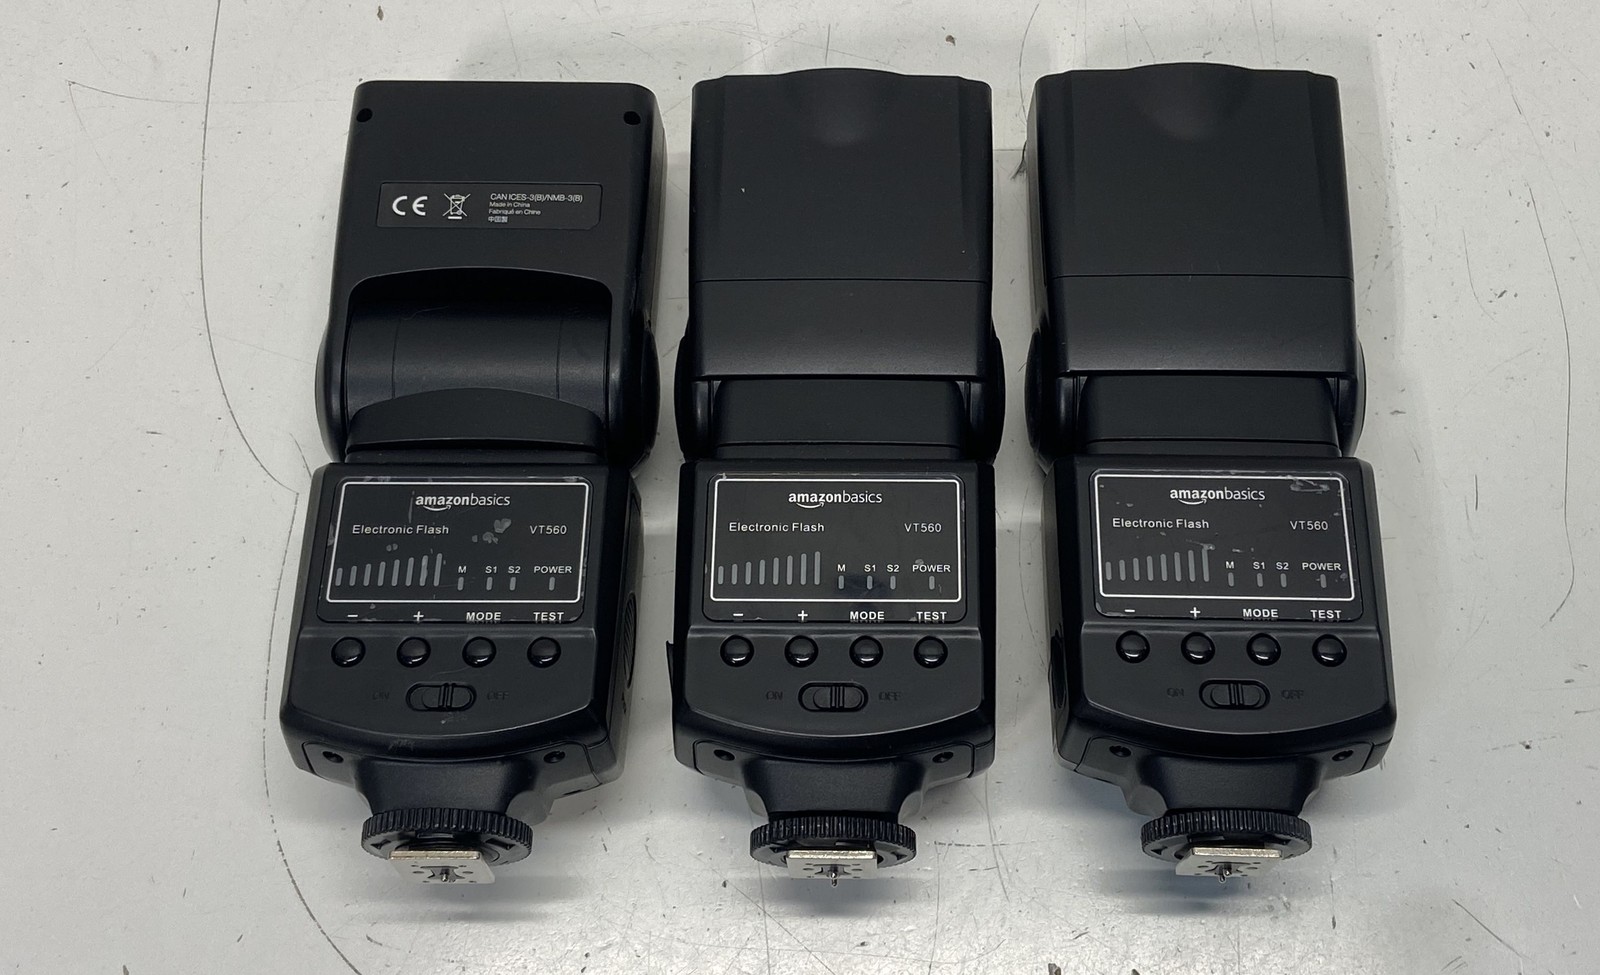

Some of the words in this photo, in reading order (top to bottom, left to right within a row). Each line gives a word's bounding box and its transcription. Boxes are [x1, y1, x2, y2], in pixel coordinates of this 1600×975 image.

[490, 193, 508, 201] CAN
[508, 193, 583, 203] ICES-3(B)/NMB-3(B)
[788, 490, 883, 509] amazonbasics
[1170, 488, 1265, 505] amazonbasics
[415, 493, 511, 511] amazonbasics
[729, 522, 789, 532] Electronic
[792, 523, 825, 532] Flash
[904, 523, 942, 533] VT560
[1112, 518, 1173, 528] Electronic
[1176, 519, 1209, 529] Flash
[1290, 521, 1328, 530] VT560
[352, 524, 413, 535] Electronic
[416, 525, 449, 534] Flash
[529, 526, 567, 535] VT560
[1226, 561, 1234, 569] M
[1275, 562, 1289, 570] S2
[1301, 563, 1341, 571] POWER
[508, 566, 521, 574] S2
[533, 566, 572, 574] POWER
[466, 612, 501, 621] MODE
[533, 612, 564, 621] TEST
[849, 611, 885, 620] MODE
[916, 611, 947, 620] TEST
[1242, 608, 1279, 618] MODE
[1310, 610, 1341, 619] TEST
